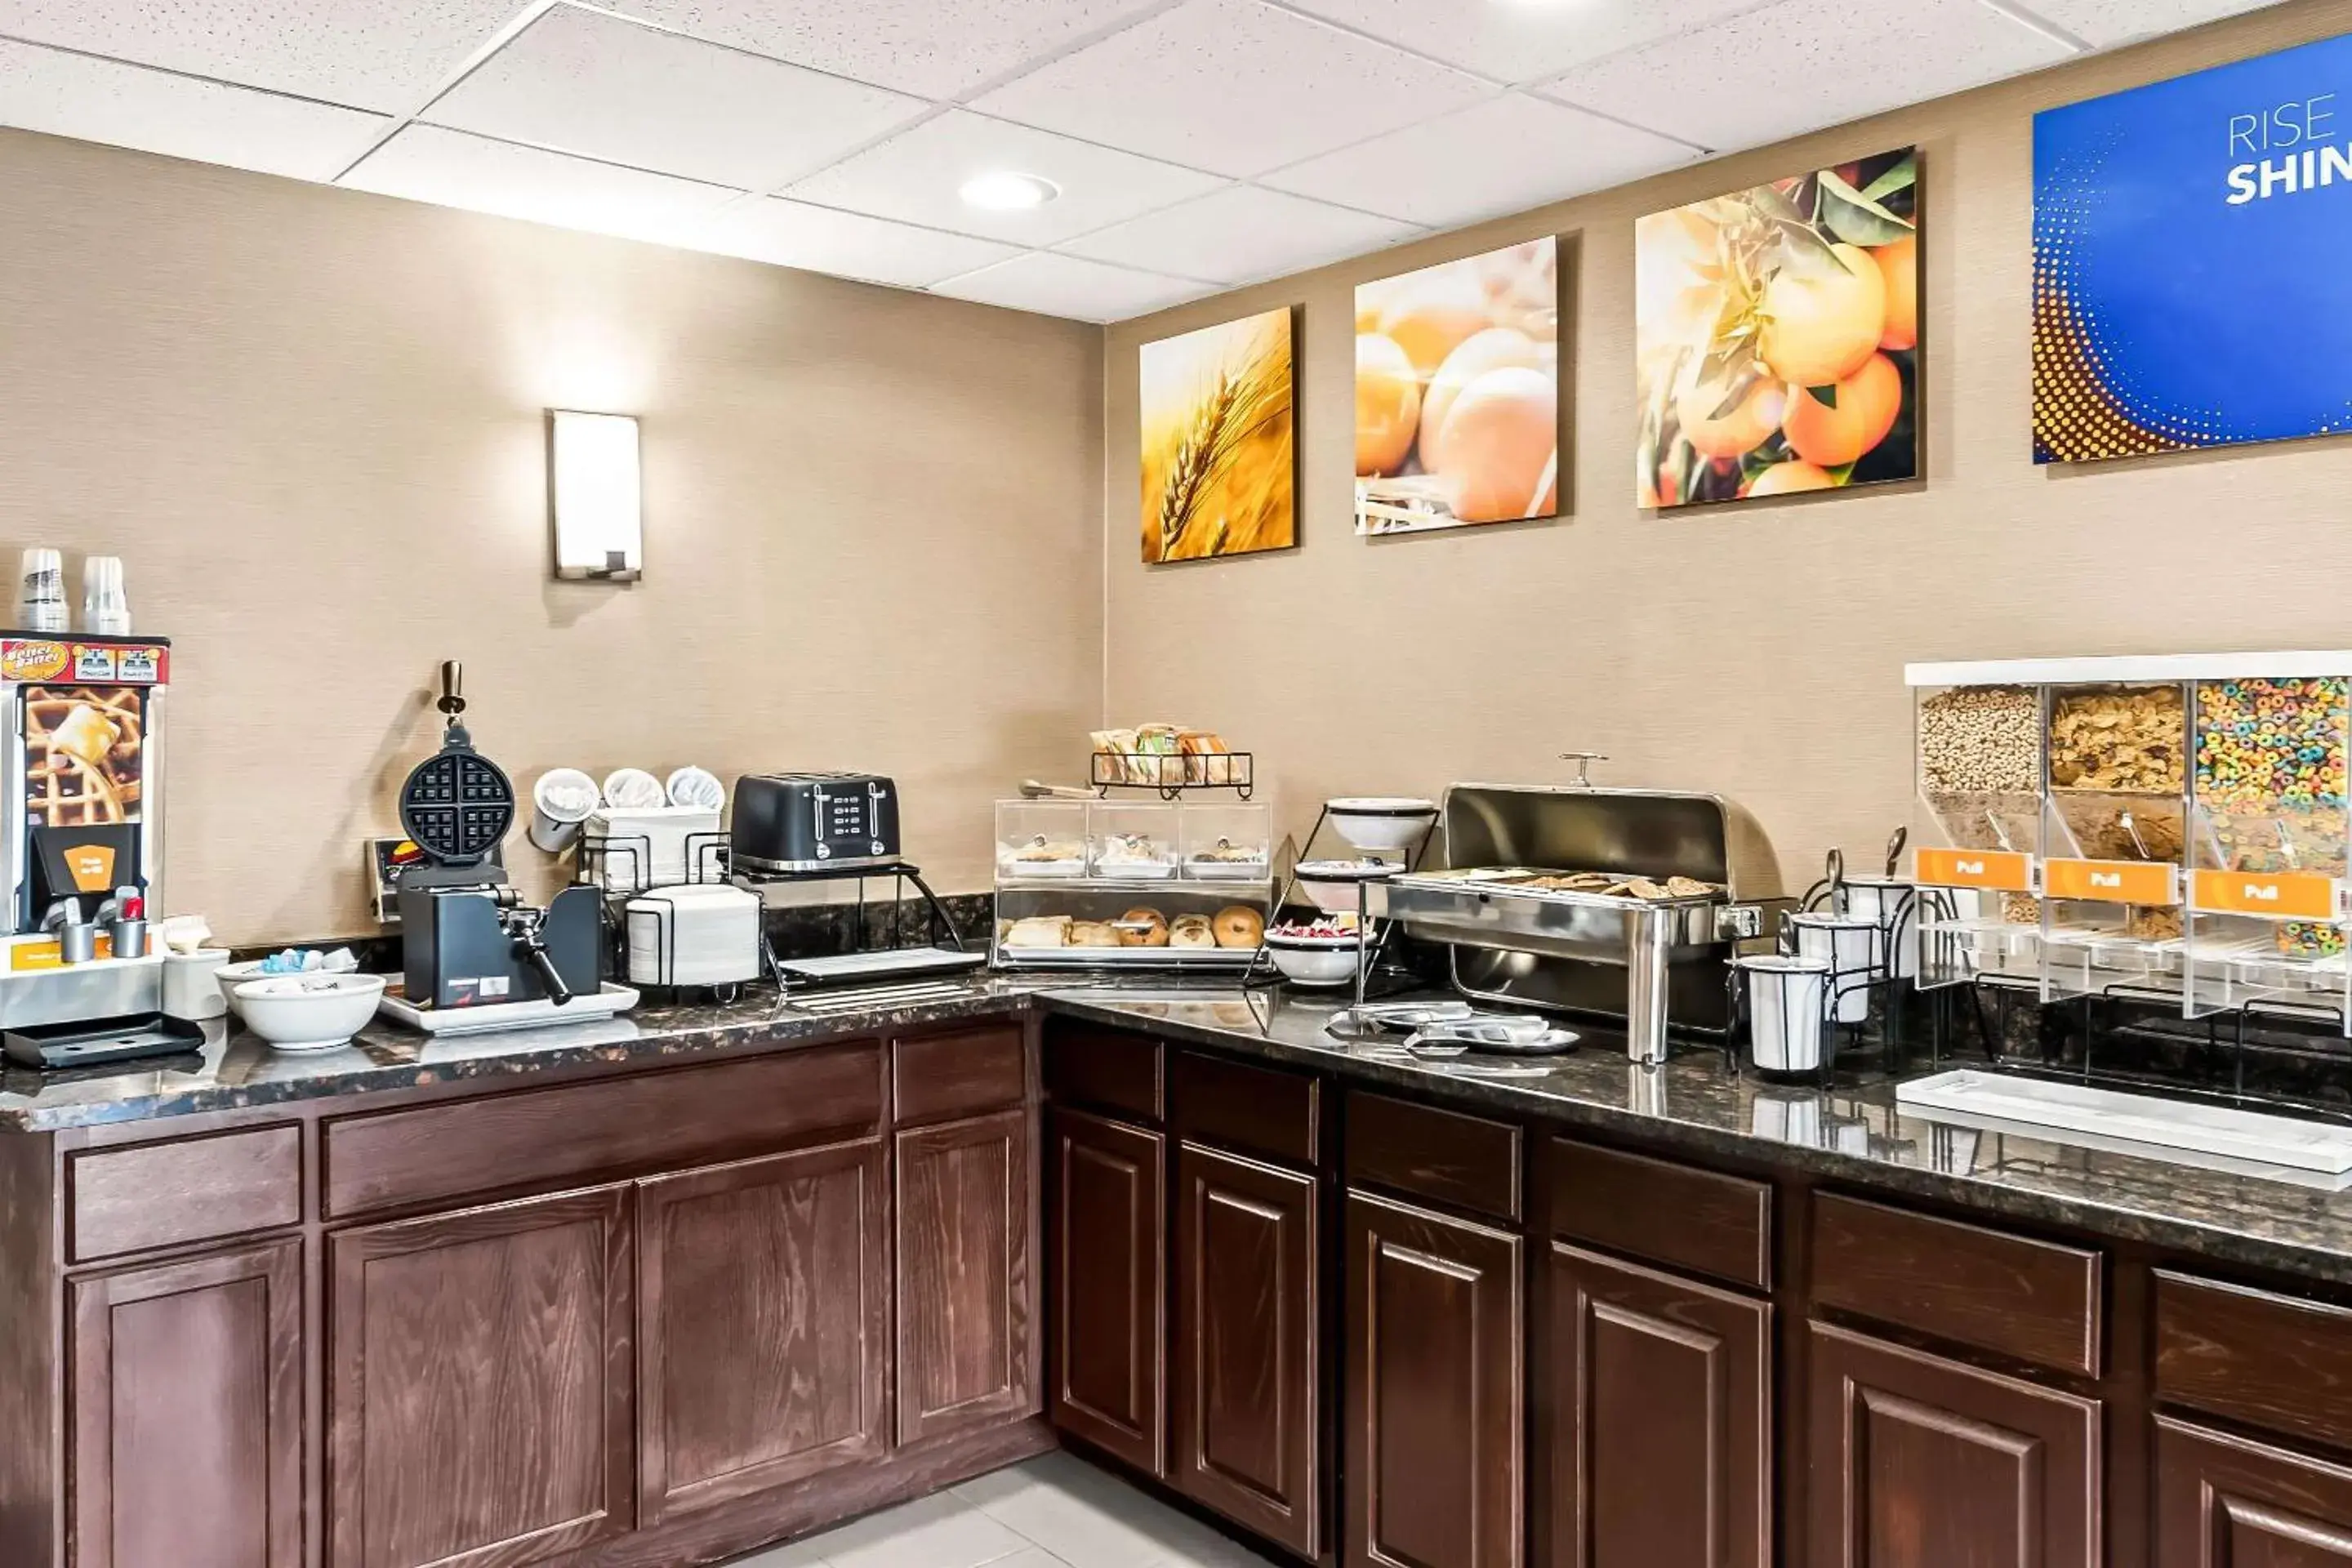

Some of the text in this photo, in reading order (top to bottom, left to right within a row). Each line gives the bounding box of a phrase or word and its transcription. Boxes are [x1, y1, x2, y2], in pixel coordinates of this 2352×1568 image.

[2230, 93, 2336, 157] RISE
[1957, 860, 1984, 874] Pull
[2091, 872, 2121, 887] Pull
[2244, 884, 2278, 900] Pull
